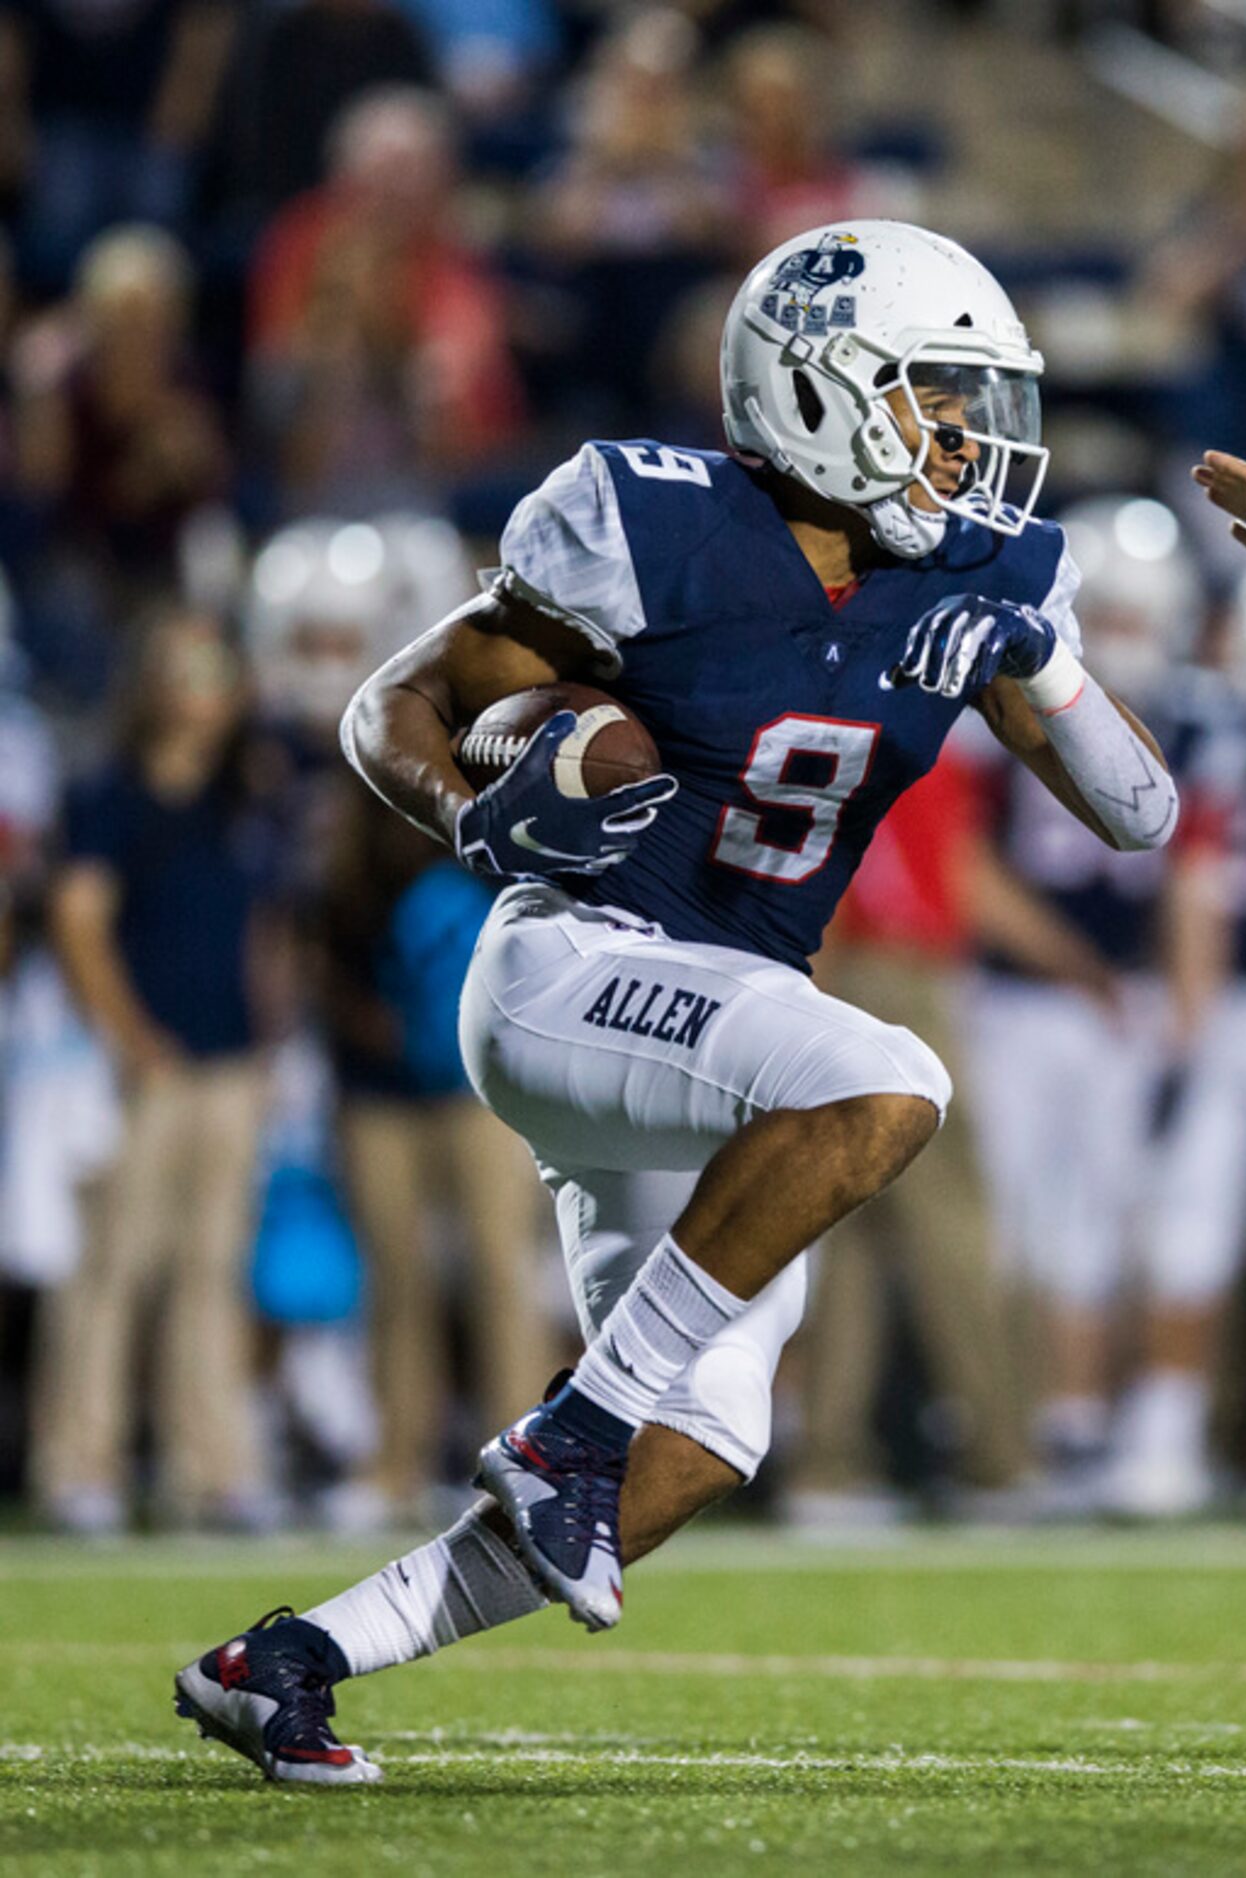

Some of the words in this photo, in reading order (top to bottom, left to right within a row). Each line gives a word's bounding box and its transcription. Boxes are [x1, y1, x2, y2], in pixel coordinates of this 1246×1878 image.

[810, 254, 834, 274] A
[617, 444, 713, 488] 9
[708, 711, 882, 884] 9
[583, 976, 721, 1049] ALLEN
